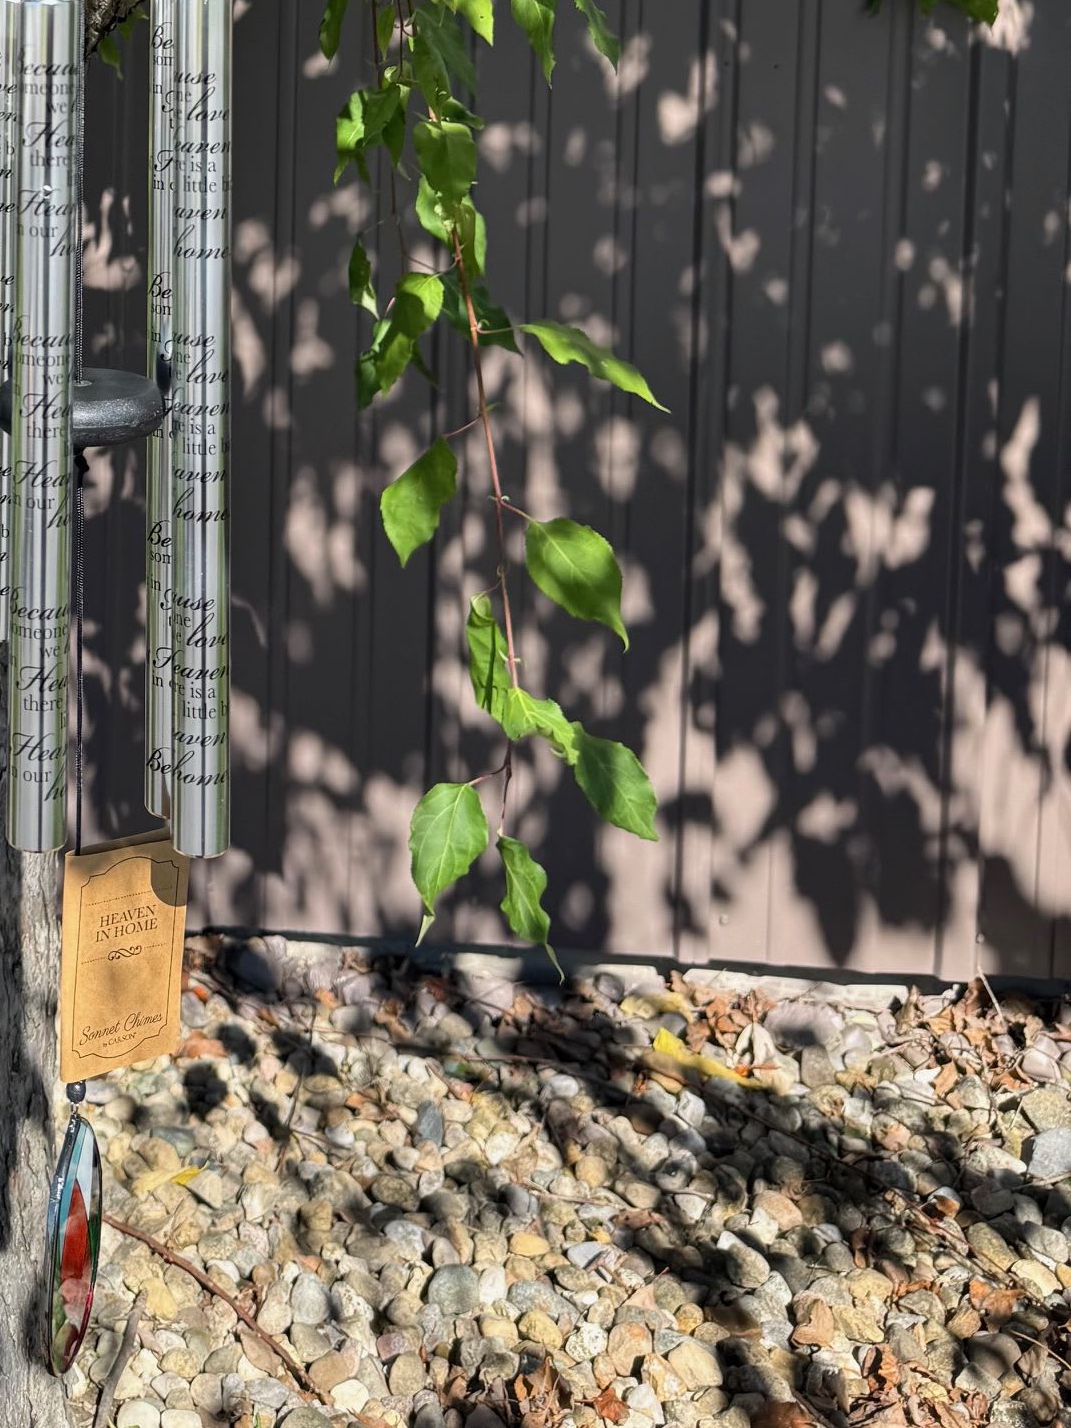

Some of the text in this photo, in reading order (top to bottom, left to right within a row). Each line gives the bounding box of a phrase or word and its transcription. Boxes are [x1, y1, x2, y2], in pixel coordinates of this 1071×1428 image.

[47, 102, 67, 113] we
[30, 150, 70, 167] there
[191, 155, 217, 172] is a
[183, 175, 217, 193] little
[29, 225, 59, 238] our
[43, 373, 64, 386] we
[27, 421, 66, 439] there
[190, 418, 216, 435] is a
[183, 437, 217, 455] little
[26, 496, 56, 510] our
[40, 645, 61, 658] we
[152, 670, 164, 687] in
[190, 681, 216, 699] is a
[23, 694, 63, 712] there
[182, 700, 217, 719] little
[23, 770, 52, 782] our
[100, 905, 156, 927] HEAVEN
[95, 918, 158, 942] IN HOME
[79, 1012, 162, 1046] Sonnet Chimes
